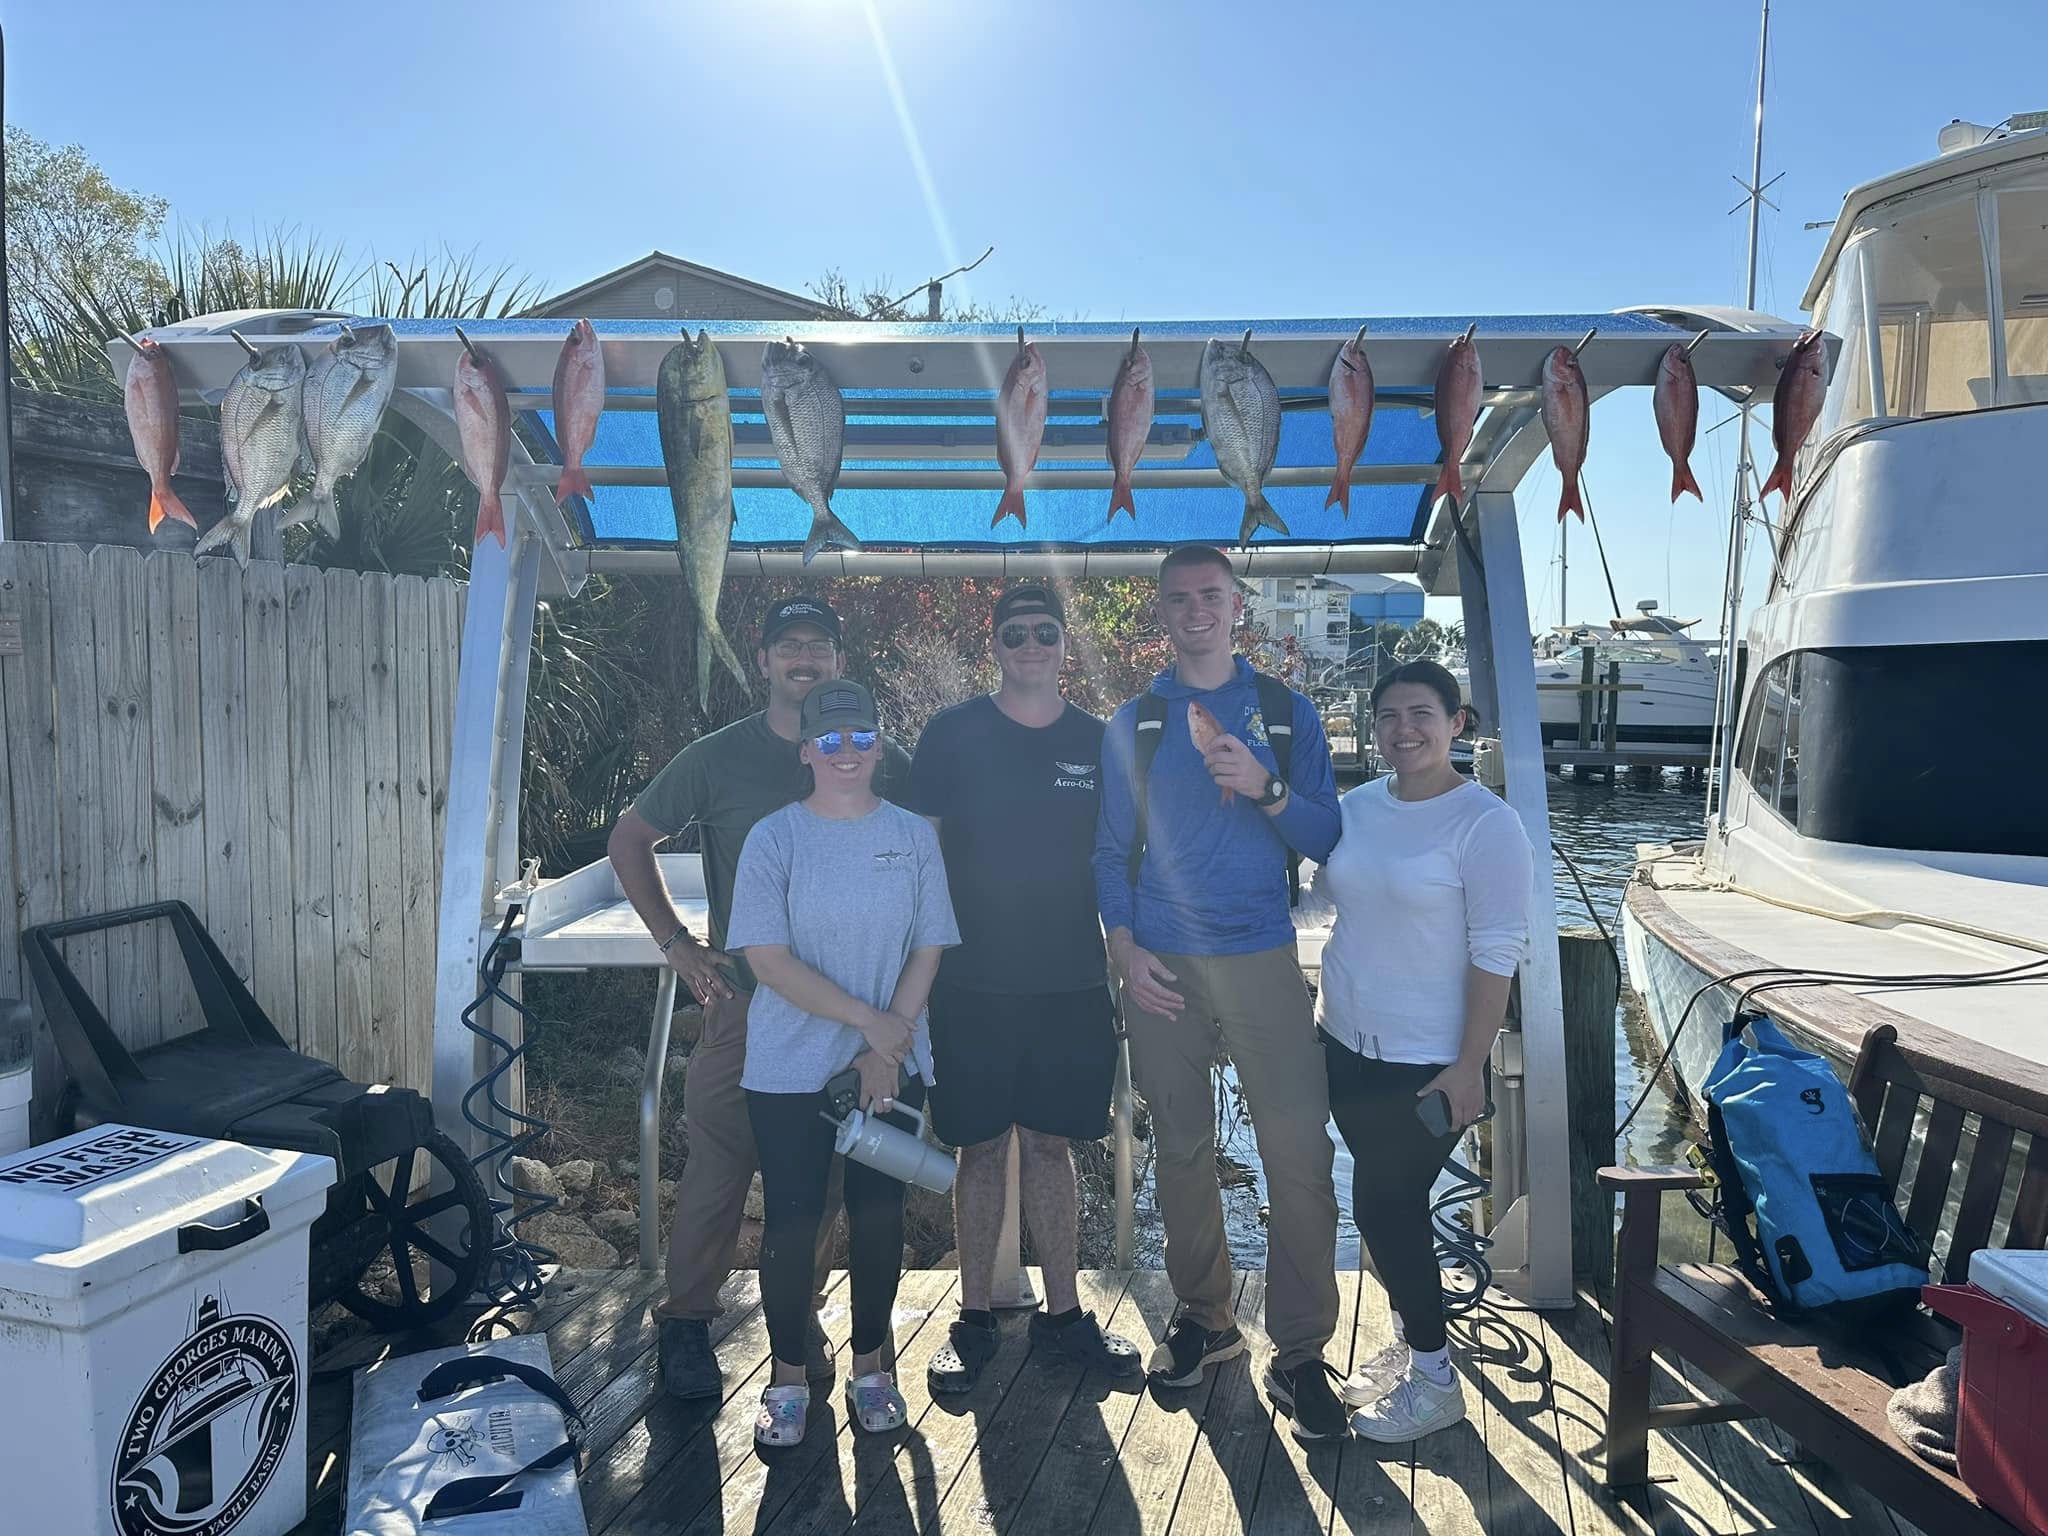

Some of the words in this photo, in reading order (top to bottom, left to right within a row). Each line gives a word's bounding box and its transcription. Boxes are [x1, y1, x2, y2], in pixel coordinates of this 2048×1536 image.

[1247, 739, 1270, 748] FLOR
[0, 1163, 66, 1184] NO
[60, 1131, 157, 1162] FISH
[38, 1138, 184, 1185] WASTE
[126, 1406, 155, 1459] TWO
[154, 1329, 228, 1400] GEORGES
[231, 1326, 287, 1371] MARINA
[208, 1491, 250, 1535] YACHT
[250, 1443, 280, 1491] BASIN
